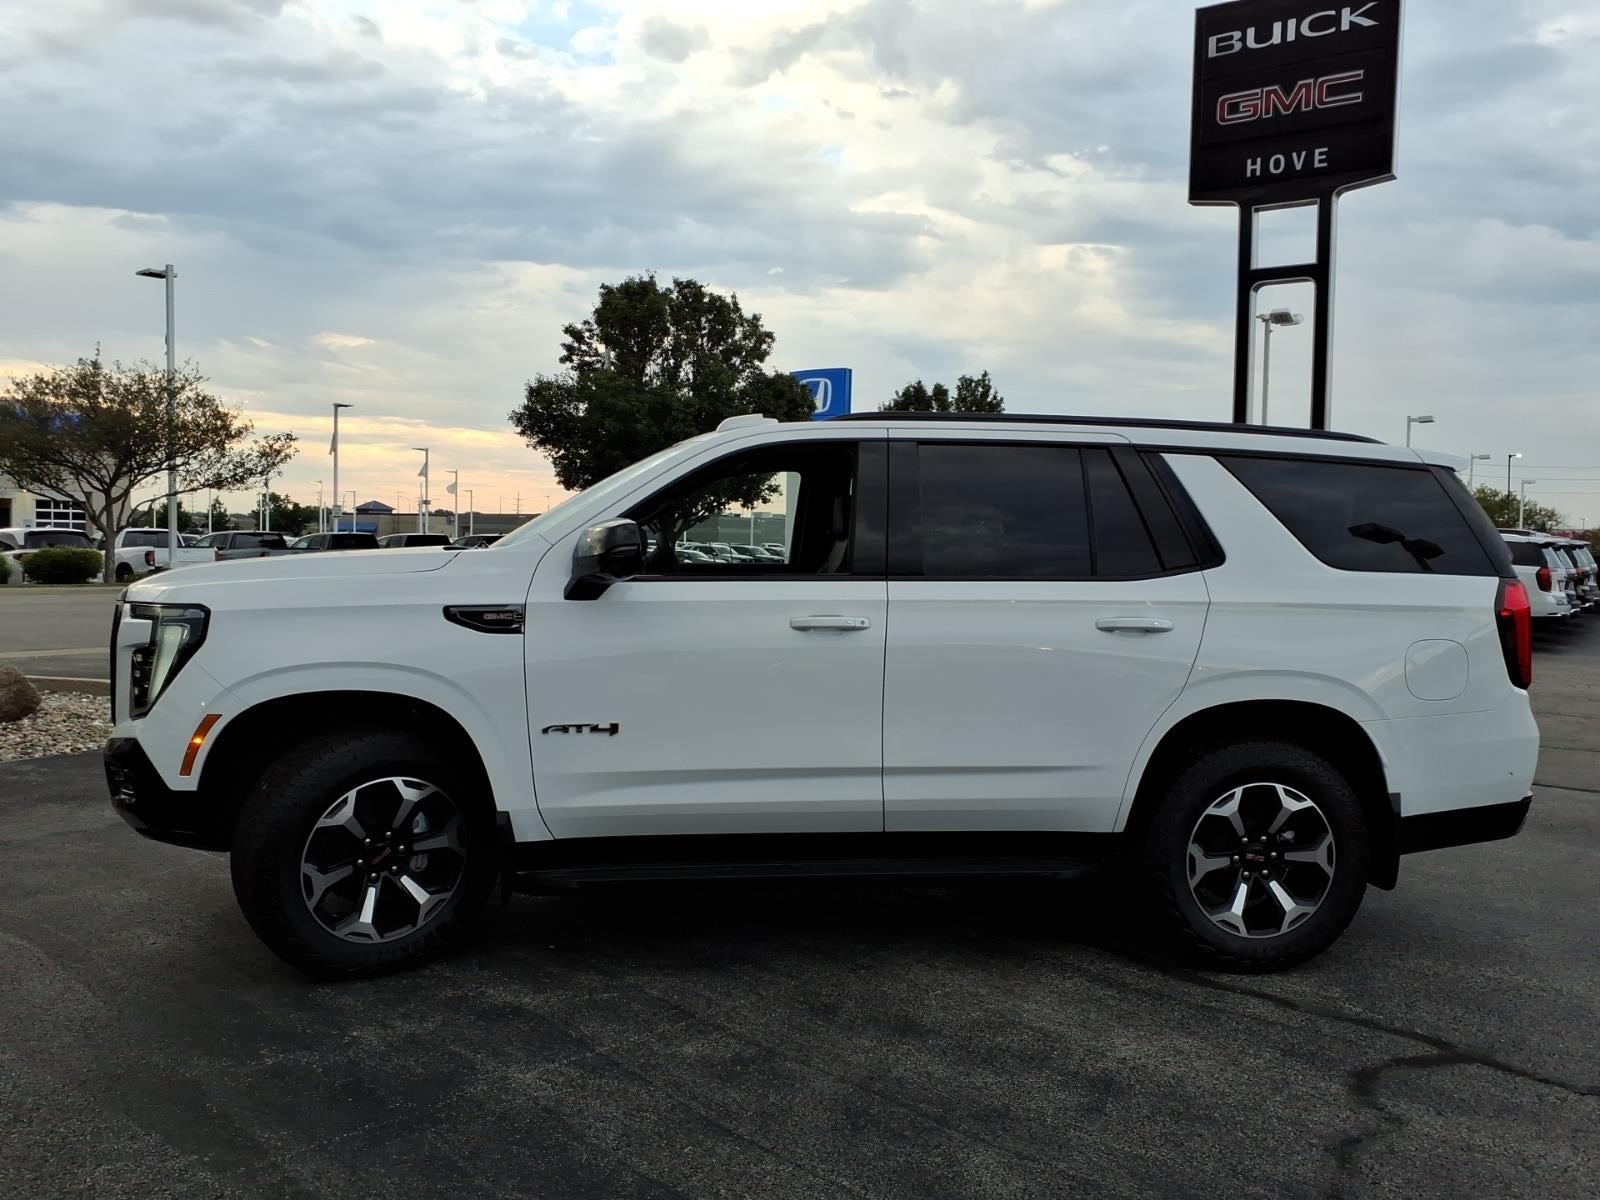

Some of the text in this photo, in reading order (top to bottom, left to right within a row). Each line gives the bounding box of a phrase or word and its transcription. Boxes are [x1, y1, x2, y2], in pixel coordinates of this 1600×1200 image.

[1208, 1, 1380, 58] BUICK
[1217, 69, 1365, 125] GMC
[1246, 147, 1330, 178] HOVE
[483, 612, 513, 620] GMC
[541, 723, 619, 736] AT4
